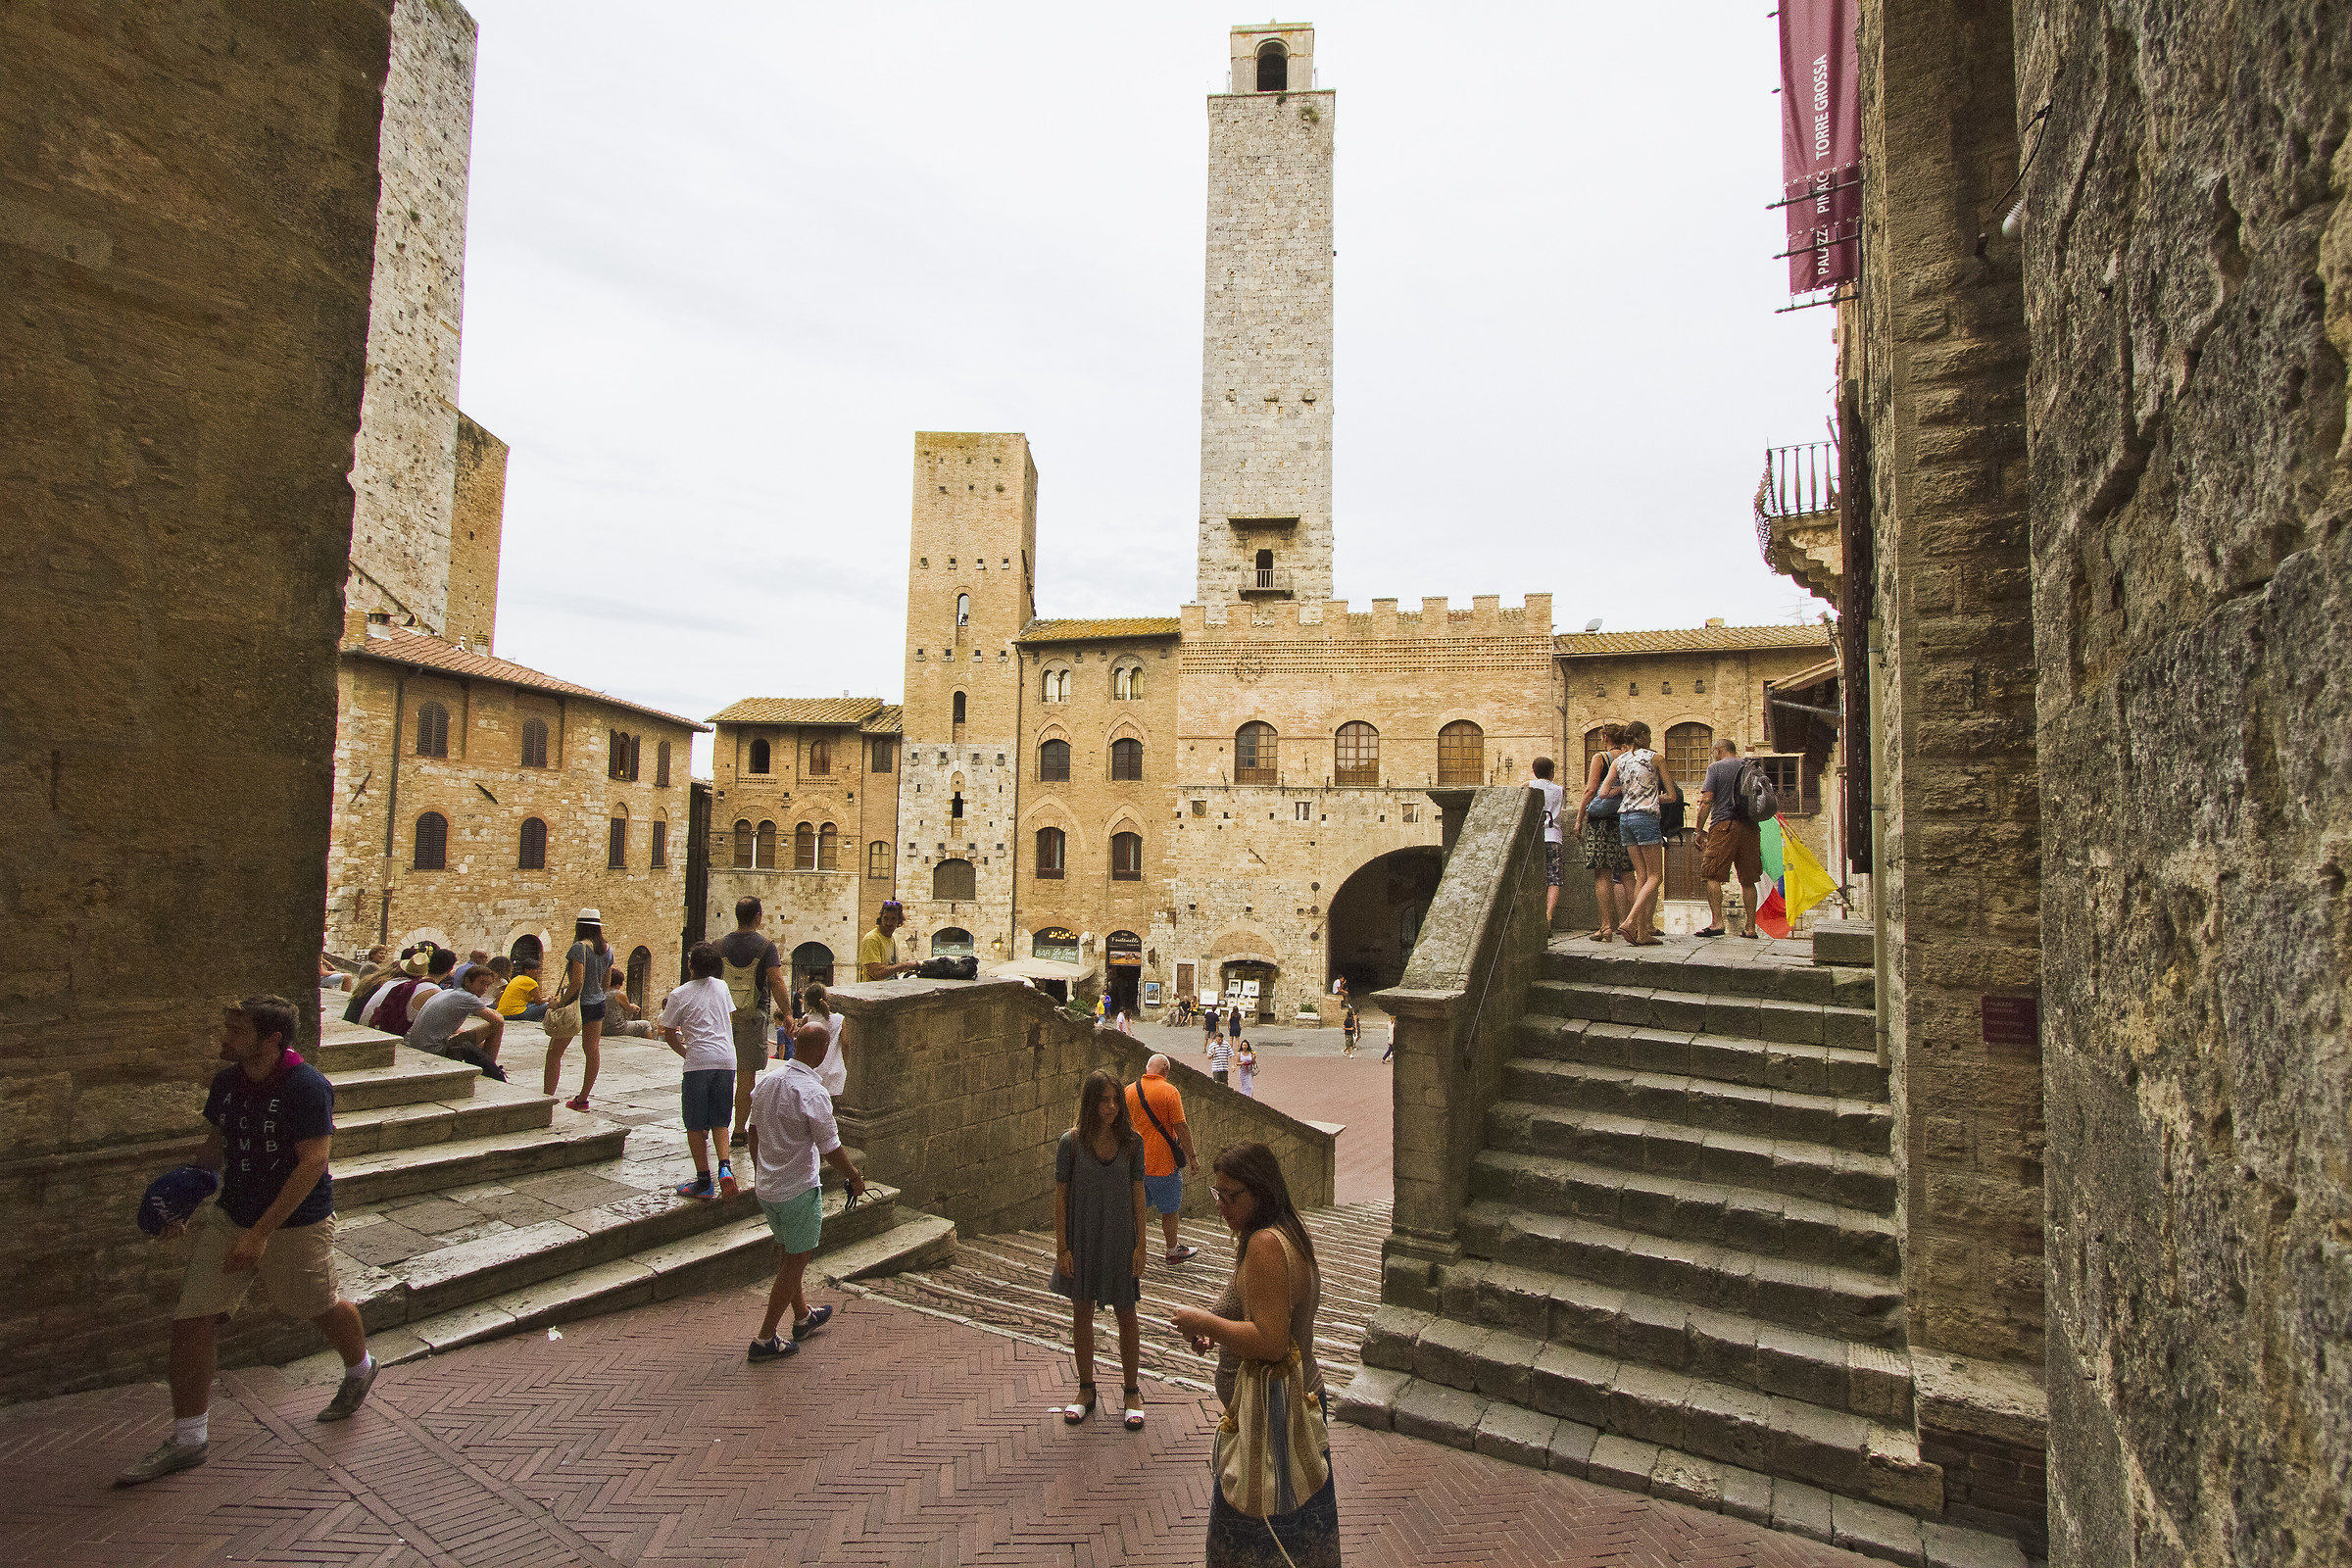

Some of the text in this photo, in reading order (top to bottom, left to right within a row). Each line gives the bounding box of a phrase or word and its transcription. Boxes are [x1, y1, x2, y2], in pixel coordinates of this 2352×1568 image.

[1813, 53, 1829, 112] GROSSA
[1815, 112, 1831, 161] TORRE
[1035, 949, 1052, 957] BAR
